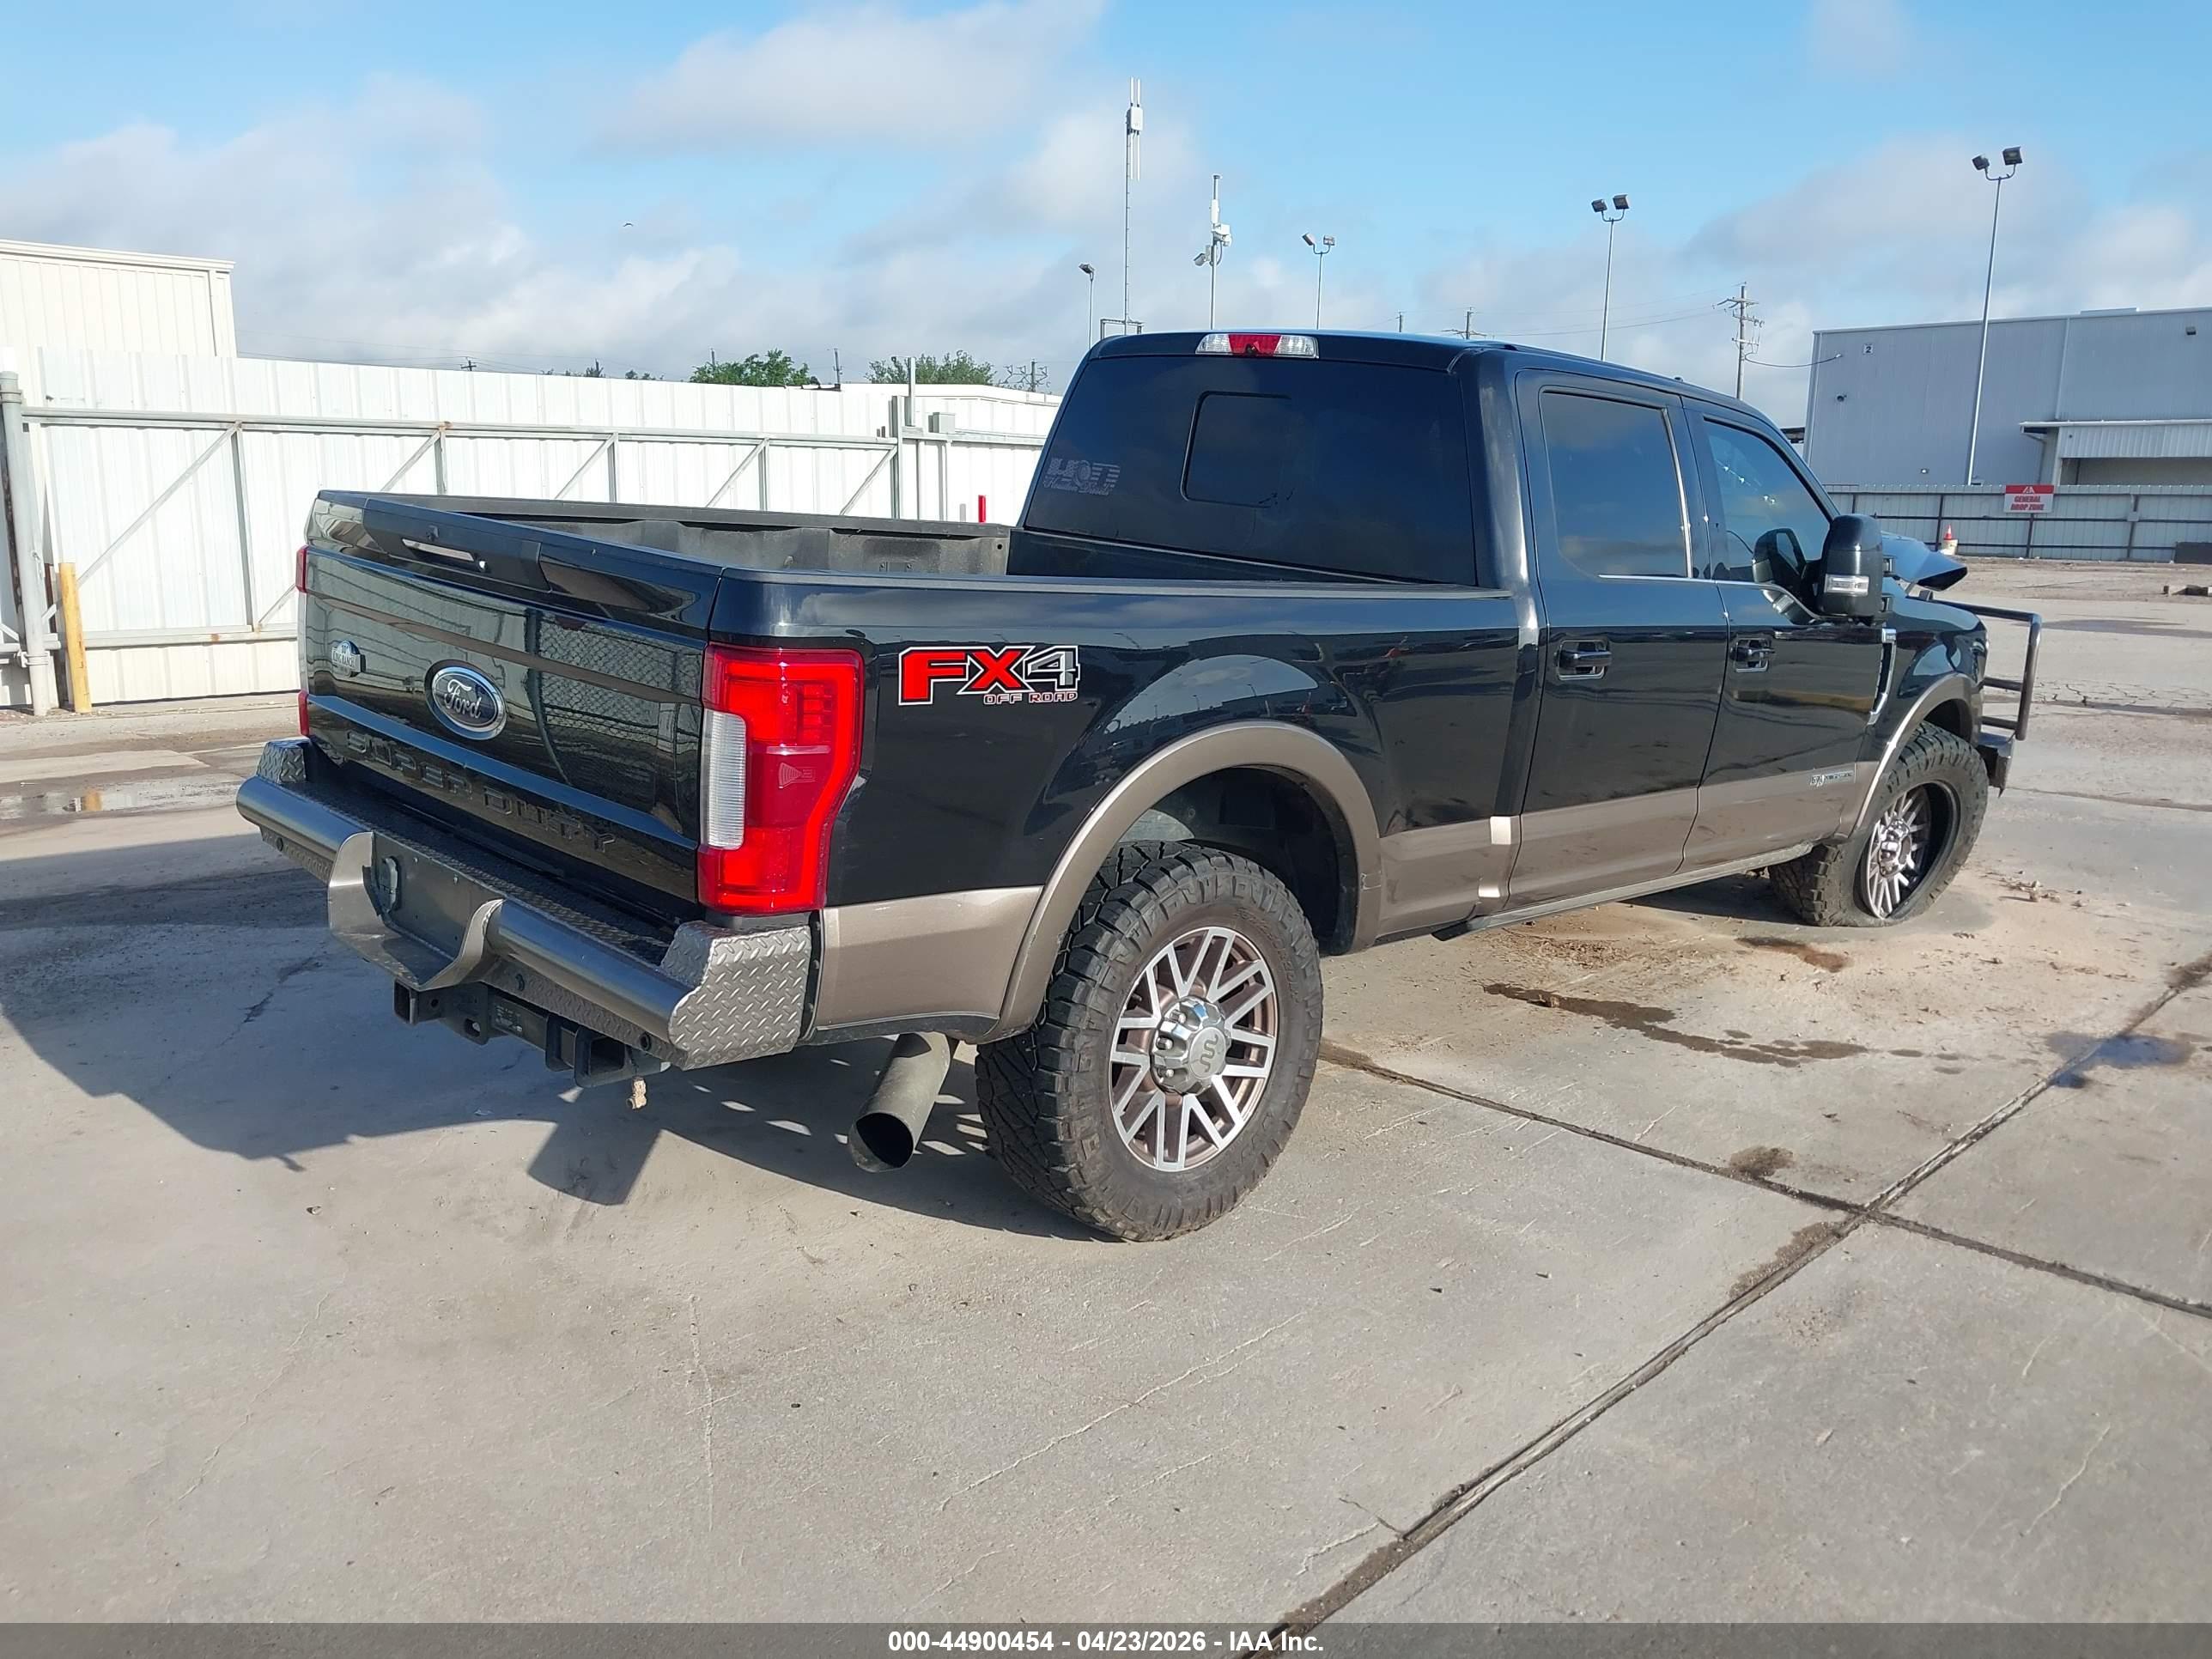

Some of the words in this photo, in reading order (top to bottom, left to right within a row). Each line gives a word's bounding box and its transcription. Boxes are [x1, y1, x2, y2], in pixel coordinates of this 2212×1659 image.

[1865, 345, 1871, 354] 2
[898, 646, 1080, 705] FX4
[443, 678, 482, 719] Ford
[983, 694, 1022, 705] OFF
[1029, 692, 1079, 703] ROAD
[346, 729, 472, 799] SUPER
[481, 785, 616, 854] DUTY
